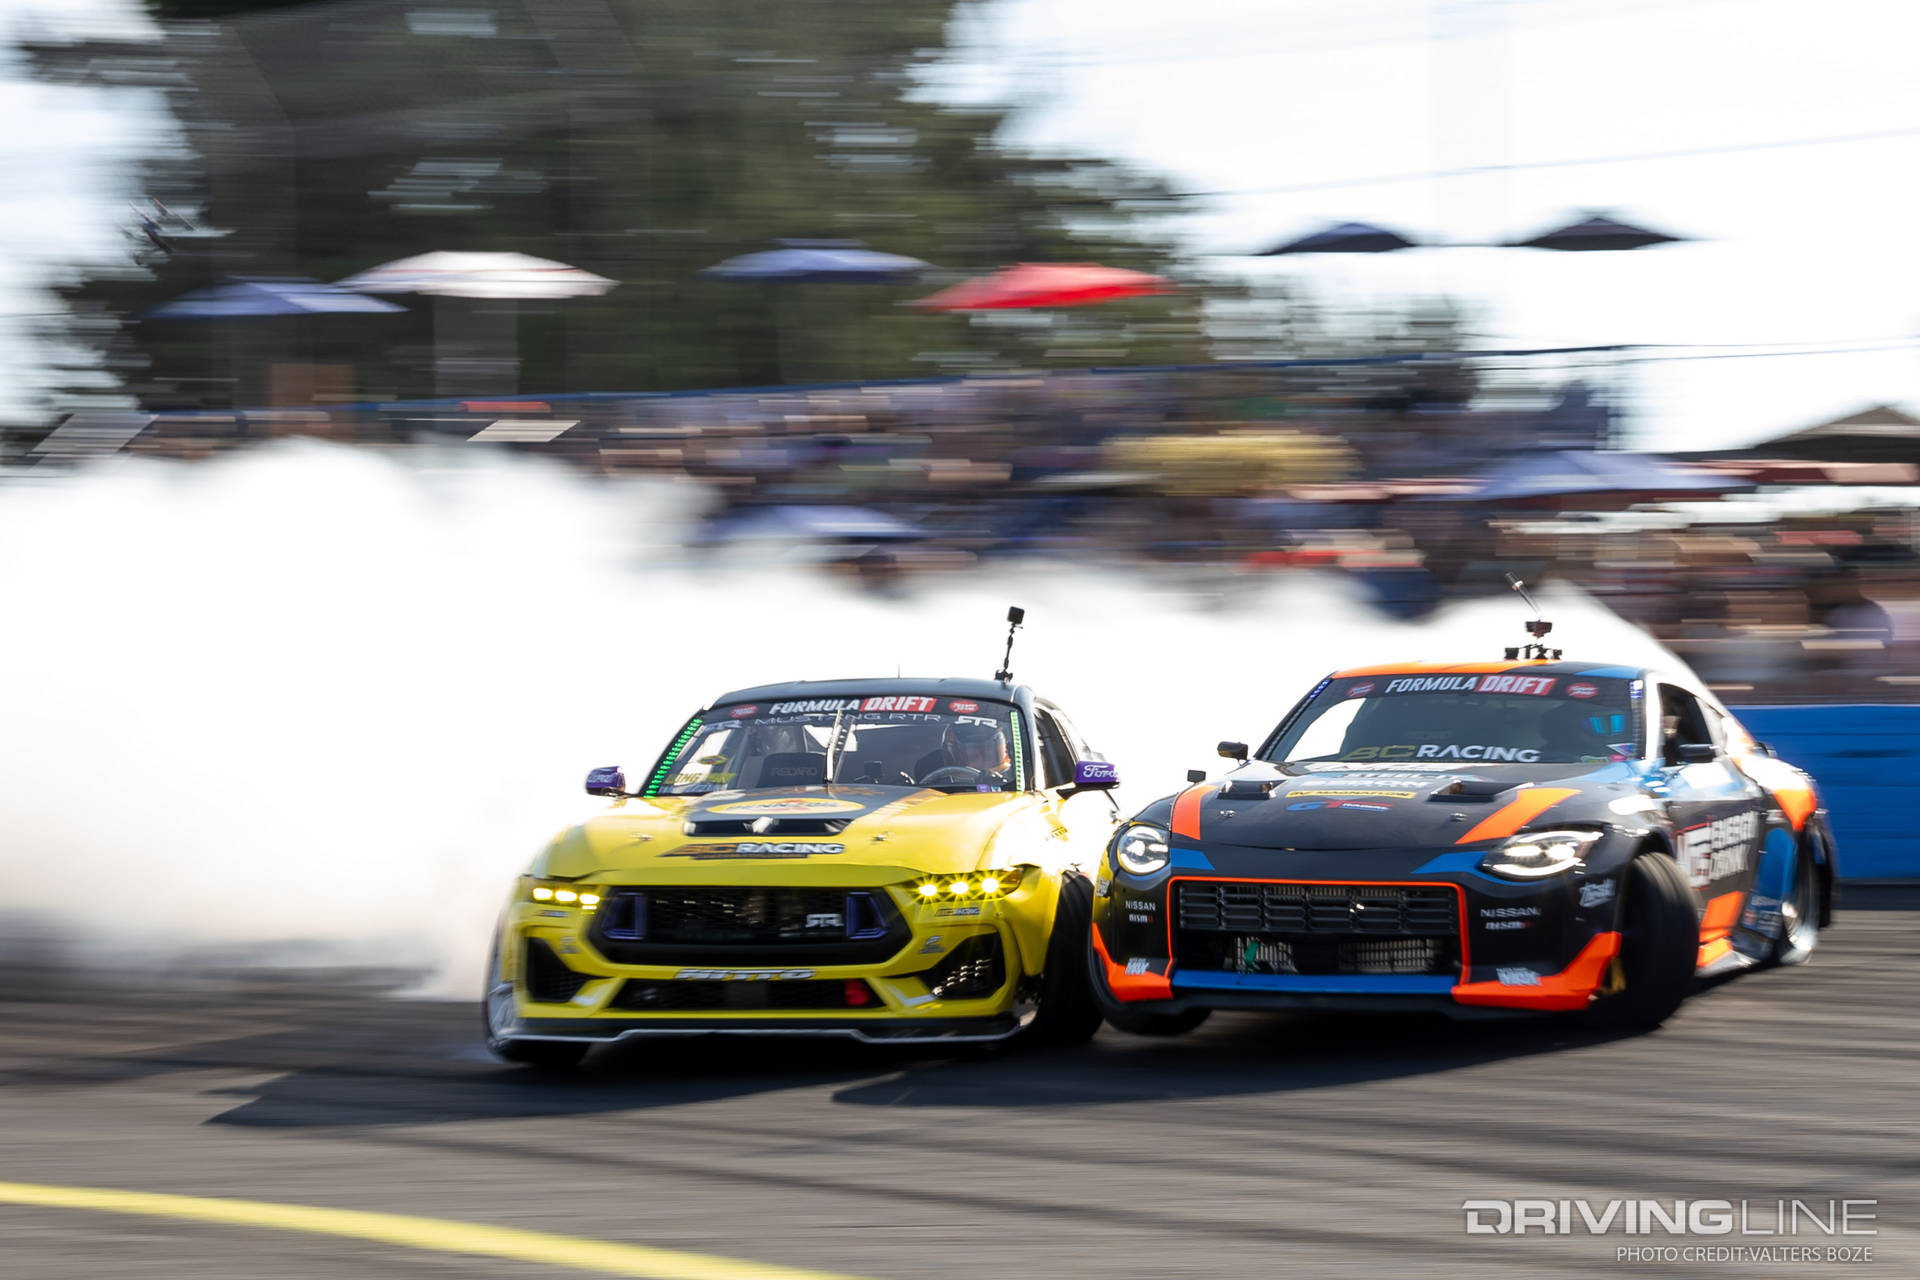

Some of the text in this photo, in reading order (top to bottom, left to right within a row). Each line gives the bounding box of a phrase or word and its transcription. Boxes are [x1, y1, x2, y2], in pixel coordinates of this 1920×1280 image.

[1384, 677, 1480, 693] FORMULA
[1478, 675, 1555, 694] DRIFT
[768, 699, 860, 715] FORMULA
[863, 697, 935, 711] DRIFT
[1416, 744, 1540, 763] RACING
[735, 843, 844, 853] RACING
[1125, 900, 1156, 911] NISSAN
[1480, 907, 1541, 917] NISSAN
